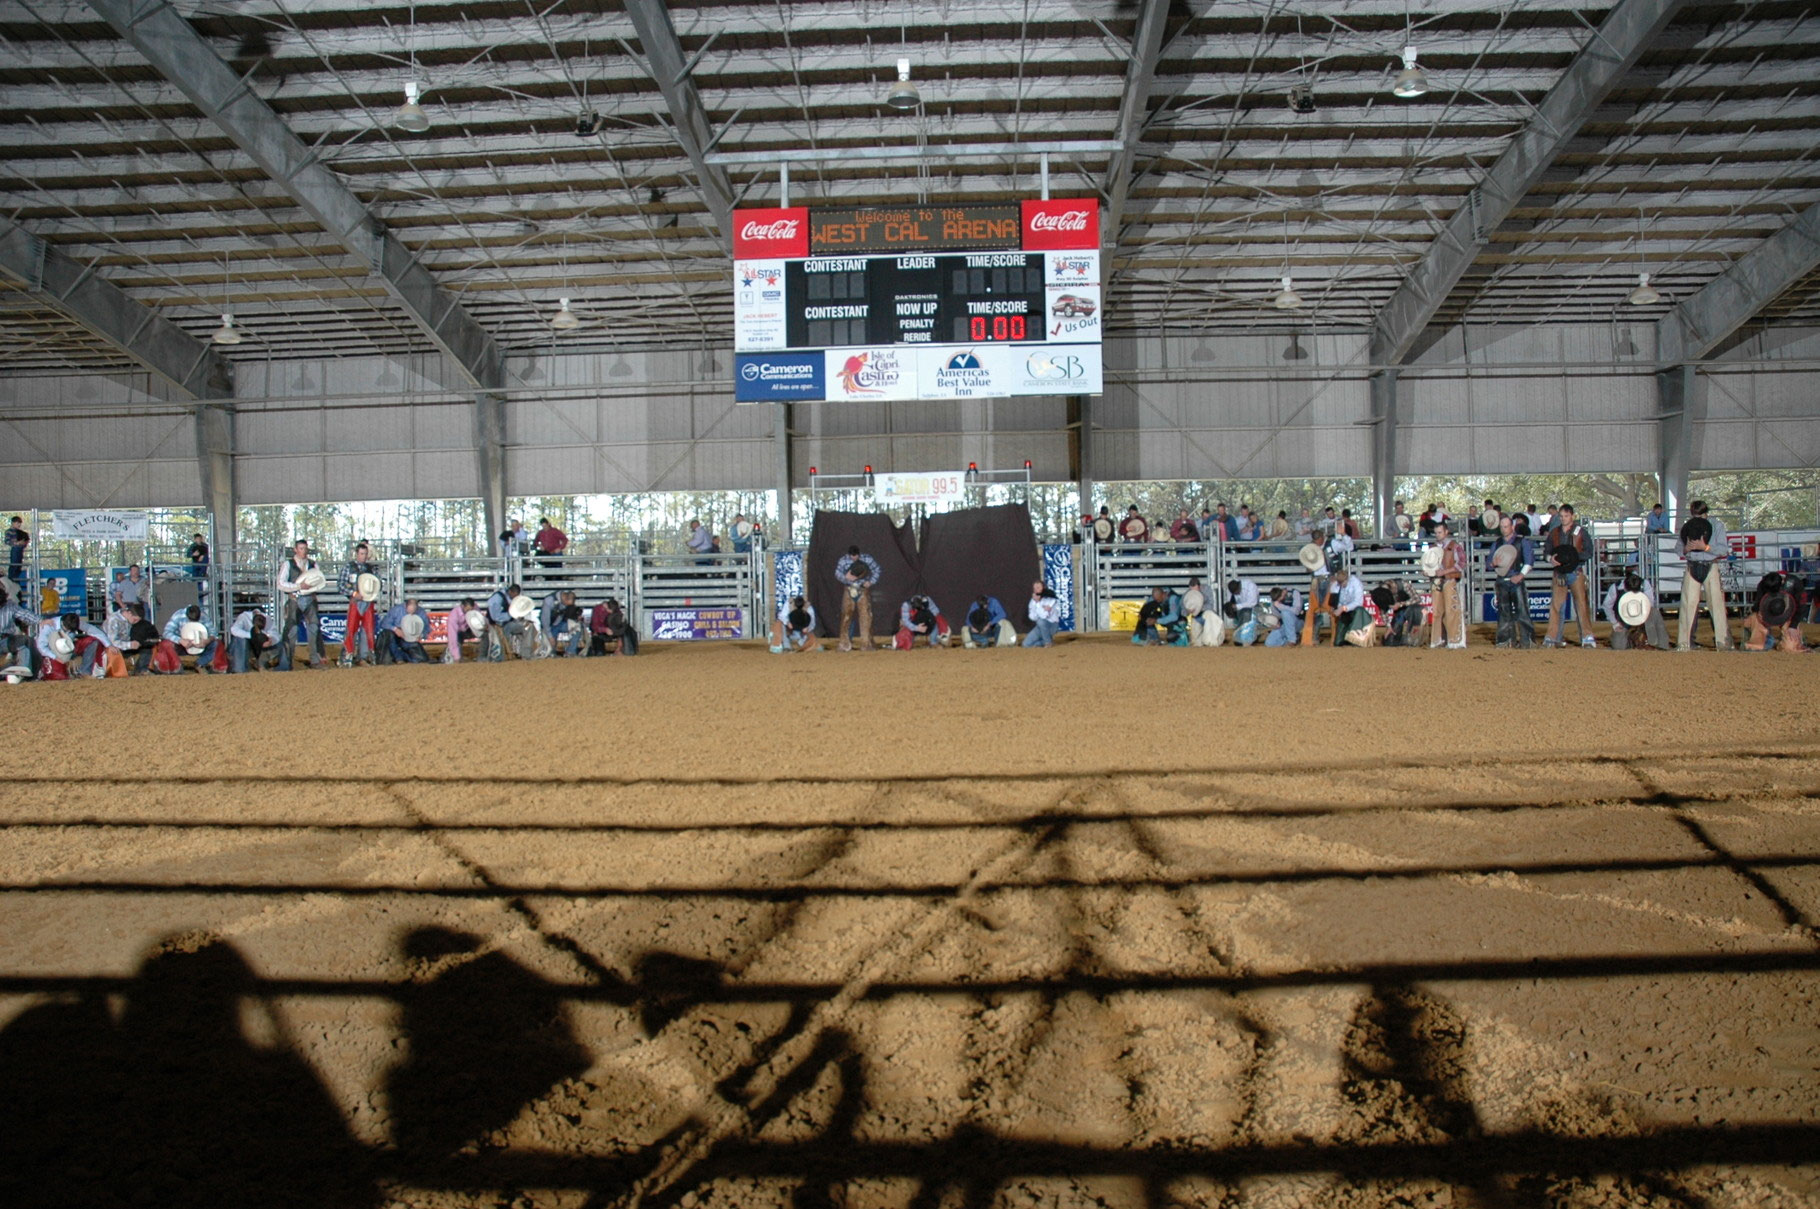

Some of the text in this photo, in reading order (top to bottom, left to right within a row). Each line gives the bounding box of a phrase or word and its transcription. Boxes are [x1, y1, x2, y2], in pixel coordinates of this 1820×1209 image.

[855, 208, 964, 223] Welcome to the
[1030, 211, 1090, 231] Coca-Cola
[741, 219, 799, 241] Coca-Cola
[811, 218, 1017, 244] WEST CAL ARENA
[804, 259, 868, 272] CONTESTANT
[897, 257, 936, 269] LEADER
[966, 254, 1027, 268] TIME/SCORE
[805, 305, 869, 319] CONTESTANT
[896, 302, 938, 315] NOW UP
[967, 301, 1028, 314] TIME/SCORE
[899, 319, 935, 329] PENALTY
[971, 315, 1025, 341] 0.00
[1065, 317, 1098, 333] Us Out
[903, 332, 932, 342] RERIDE
[871, 351, 896, 361] Isle of
[760, 363, 813, 374] Cameron
[936, 367, 990, 378] Americas
[937, 376, 991, 388] Best Value
[955, 387, 972, 396] Inn
[932, 476, 958, 494] 99.5
[72, 515, 130, 532] FLETCHER'S
[676, 611, 697, 619] MAGIC
